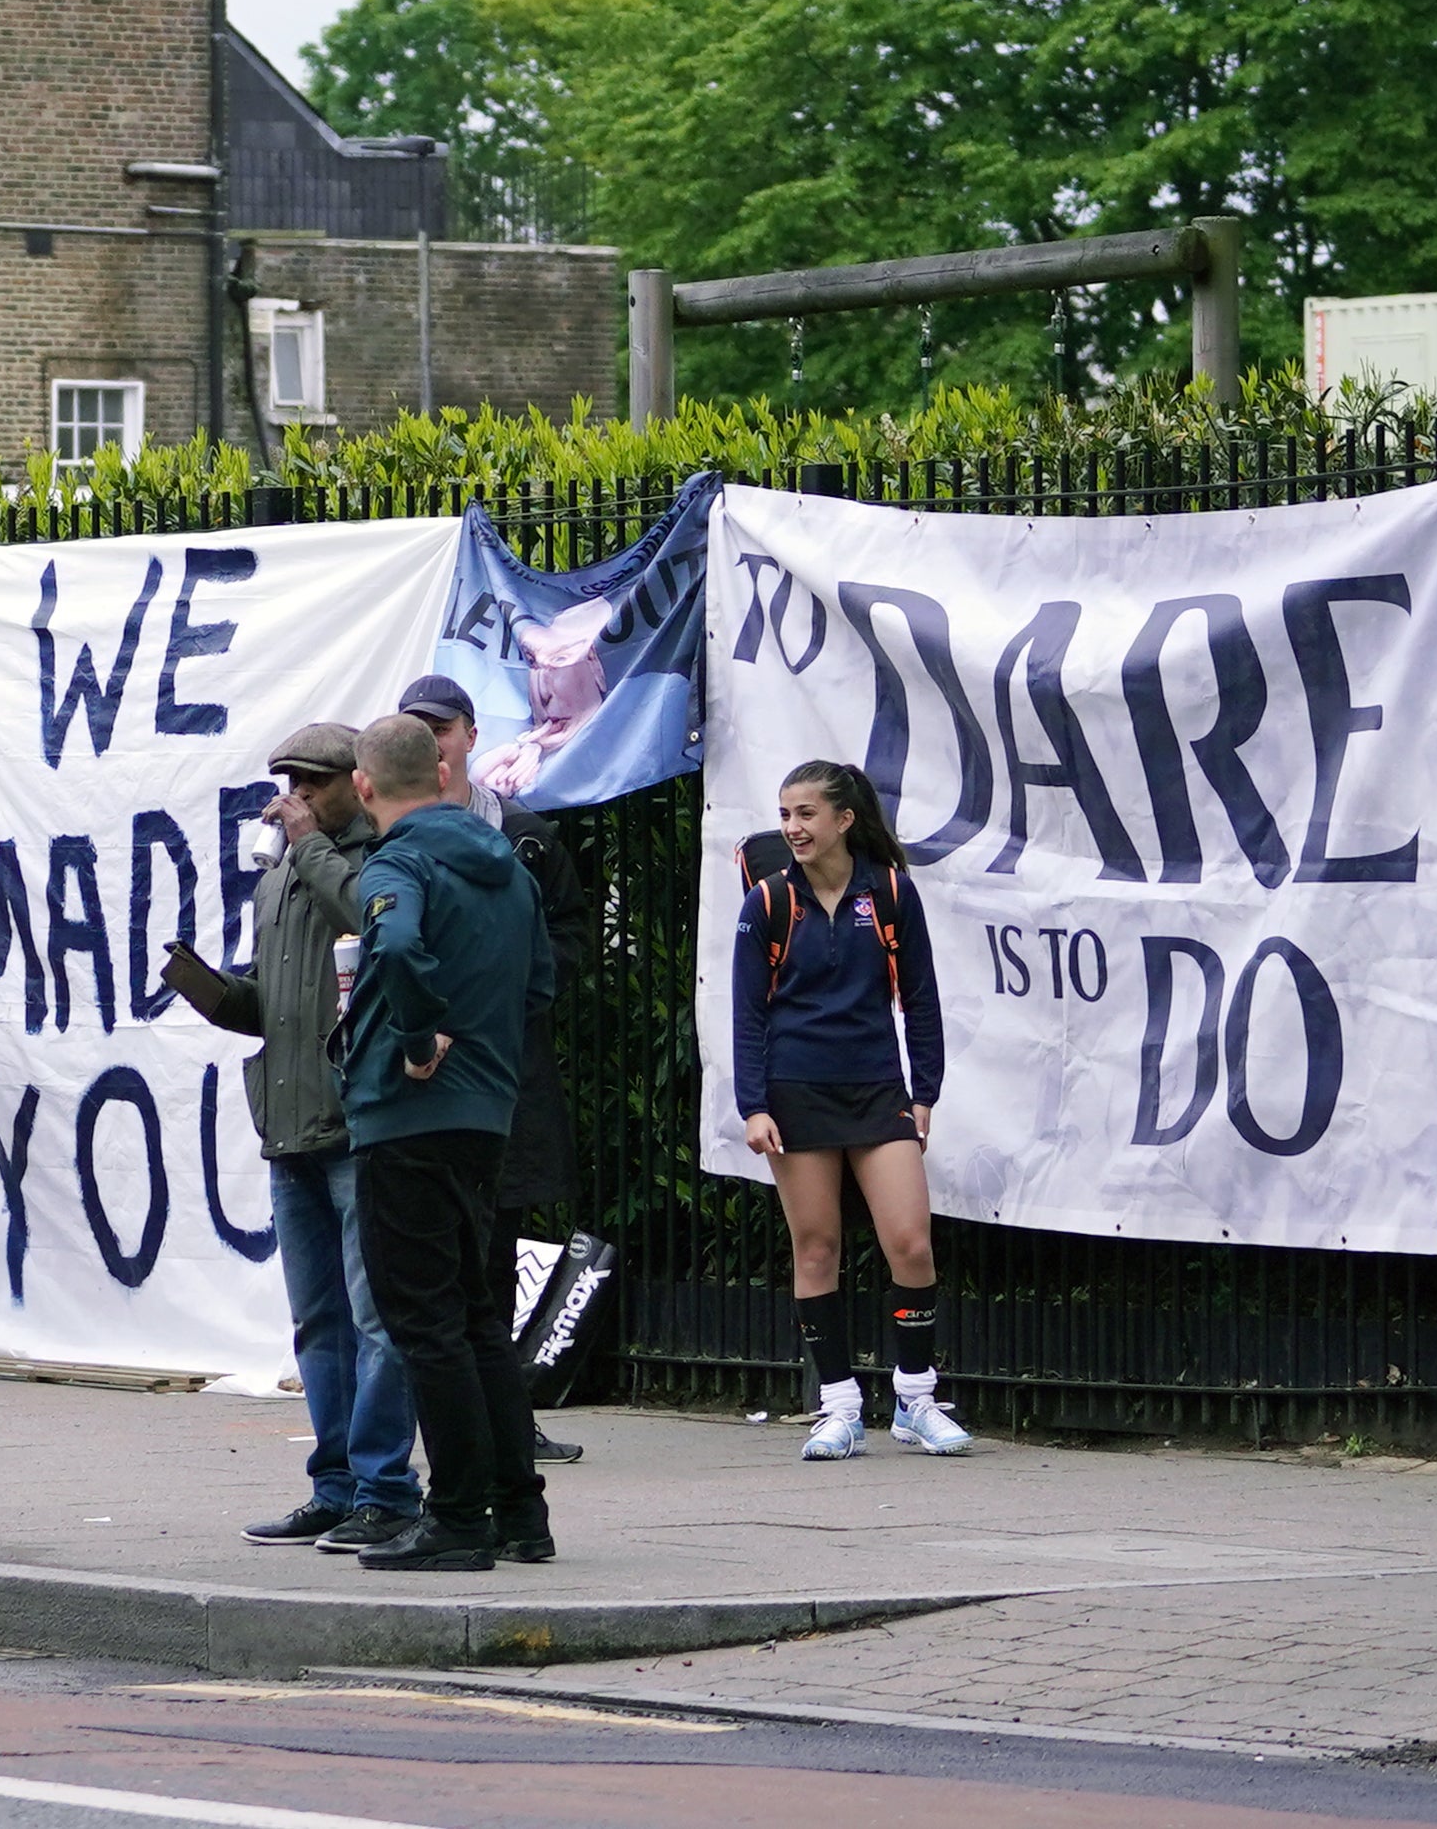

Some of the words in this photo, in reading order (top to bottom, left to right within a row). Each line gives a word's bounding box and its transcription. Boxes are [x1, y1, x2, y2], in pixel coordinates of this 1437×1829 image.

[31, 547, 259, 771] WE
[730, 552, 827, 676] TO
[837, 571, 1422, 890] DARE
[985, 923, 1031, 999] IS
[1038, 928, 1109, 1003] TO
[1130, 935, 1344, 1157] DO
